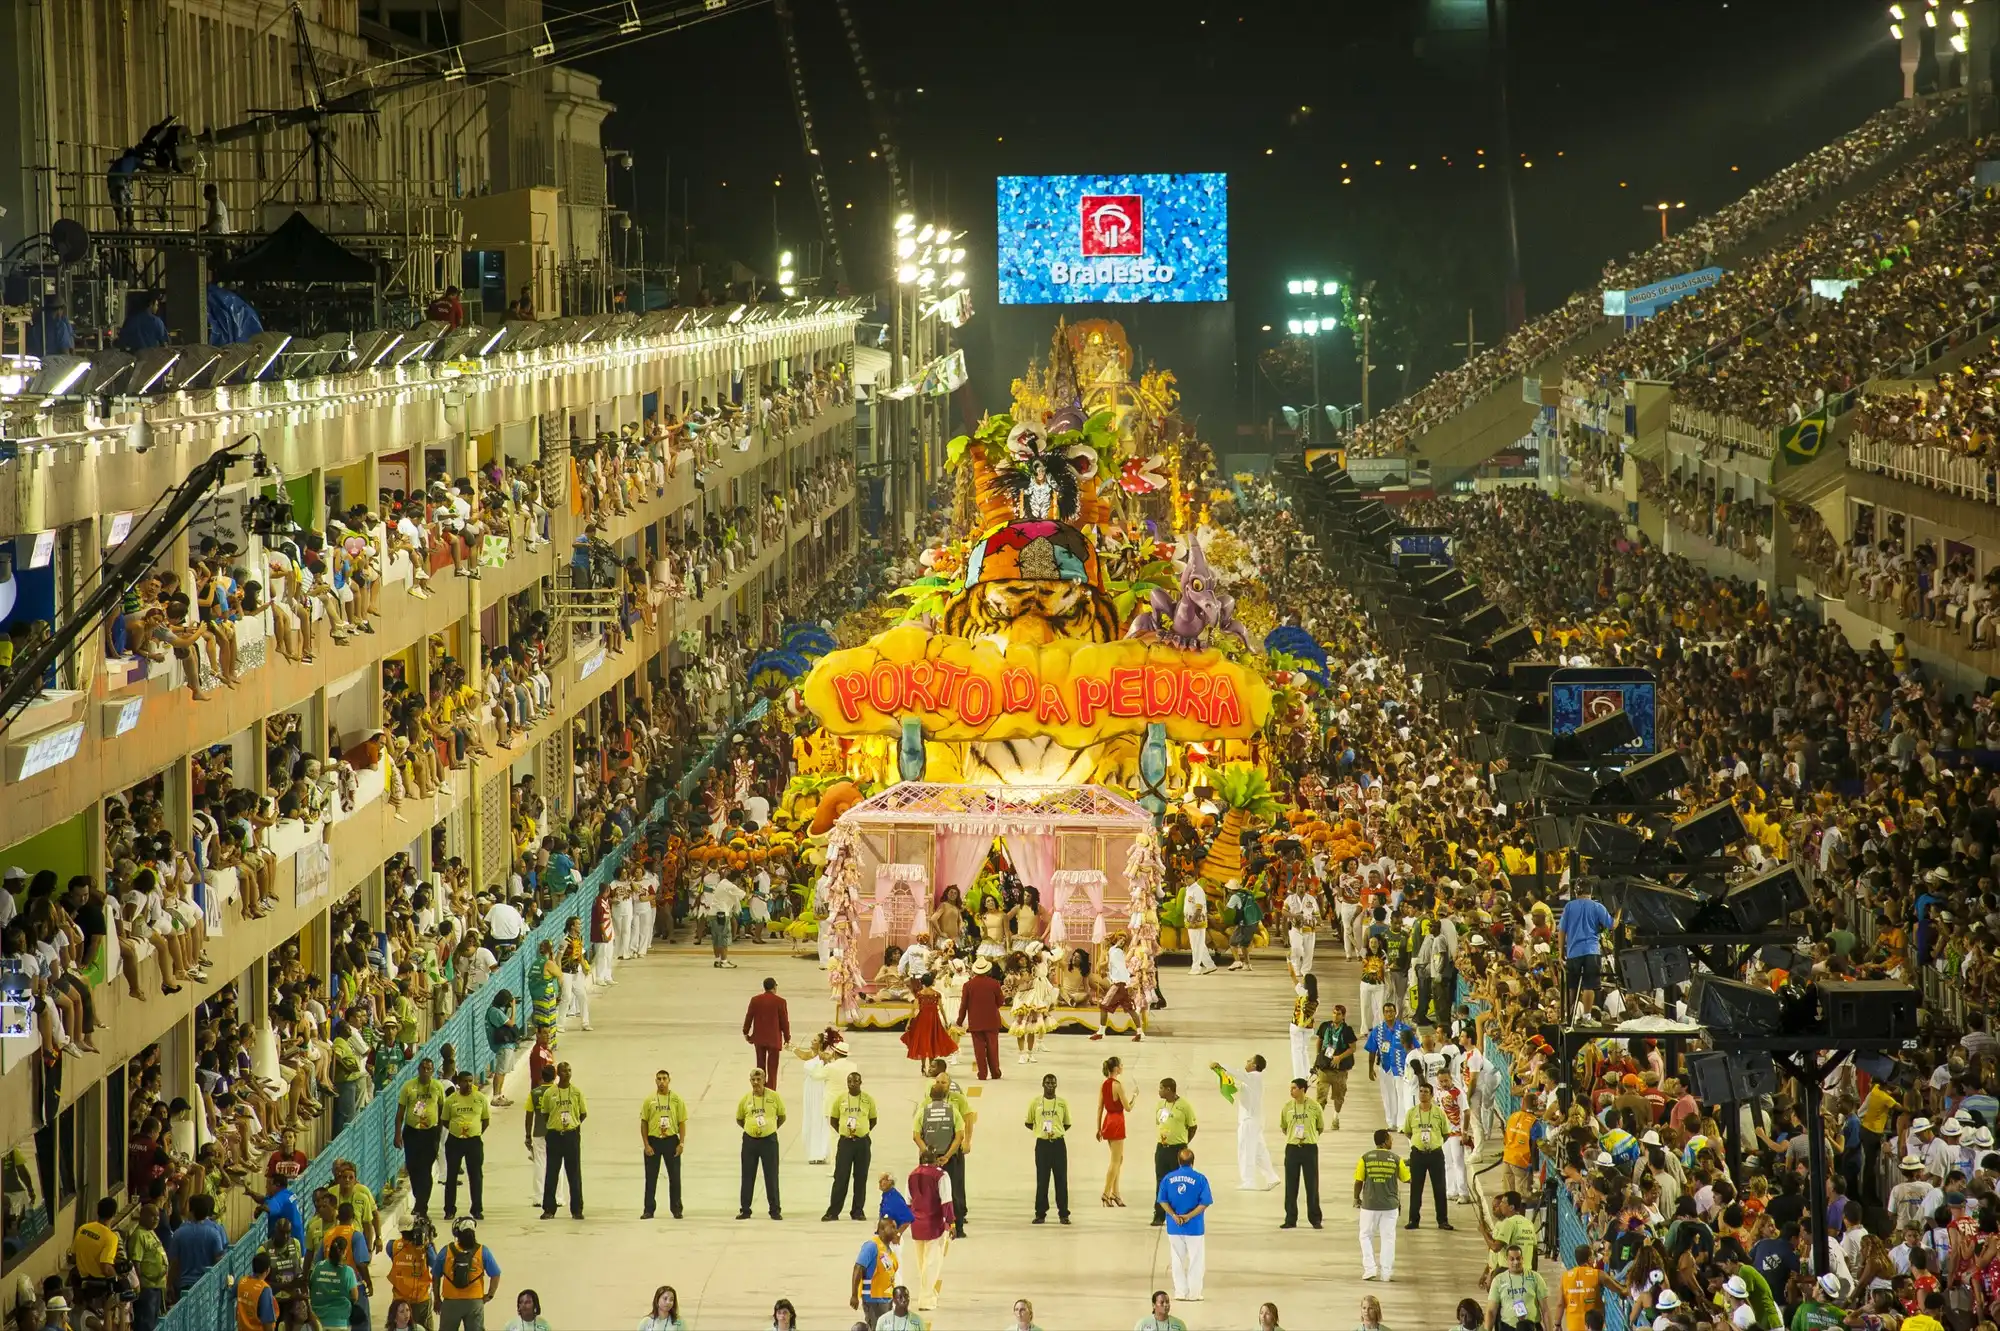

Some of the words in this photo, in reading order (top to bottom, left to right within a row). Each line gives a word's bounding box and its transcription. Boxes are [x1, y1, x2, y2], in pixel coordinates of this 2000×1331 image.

[1628, 289, 1657, 304] UNIDOS
[1659, 287, 1669, 296] DE
[1670, 280, 1688, 292] VILA
[1688, 273, 1716, 288] ISABEL
[833, 659, 992, 726] PORTO
[1002, 666, 1069, 724] DA
[1076, 665, 1242, 726] PEDRA
[1676, 805, 1688, 813] 22
[1732, 865, 1745, 873] 23
[1797, 936, 1811, 944] 24
[1902, 1039, 1918, 1049] 25
[1169, 1175, 1196, 1186] DIRETORIA
[1507, 1287, 1527, 1296] PISTA
